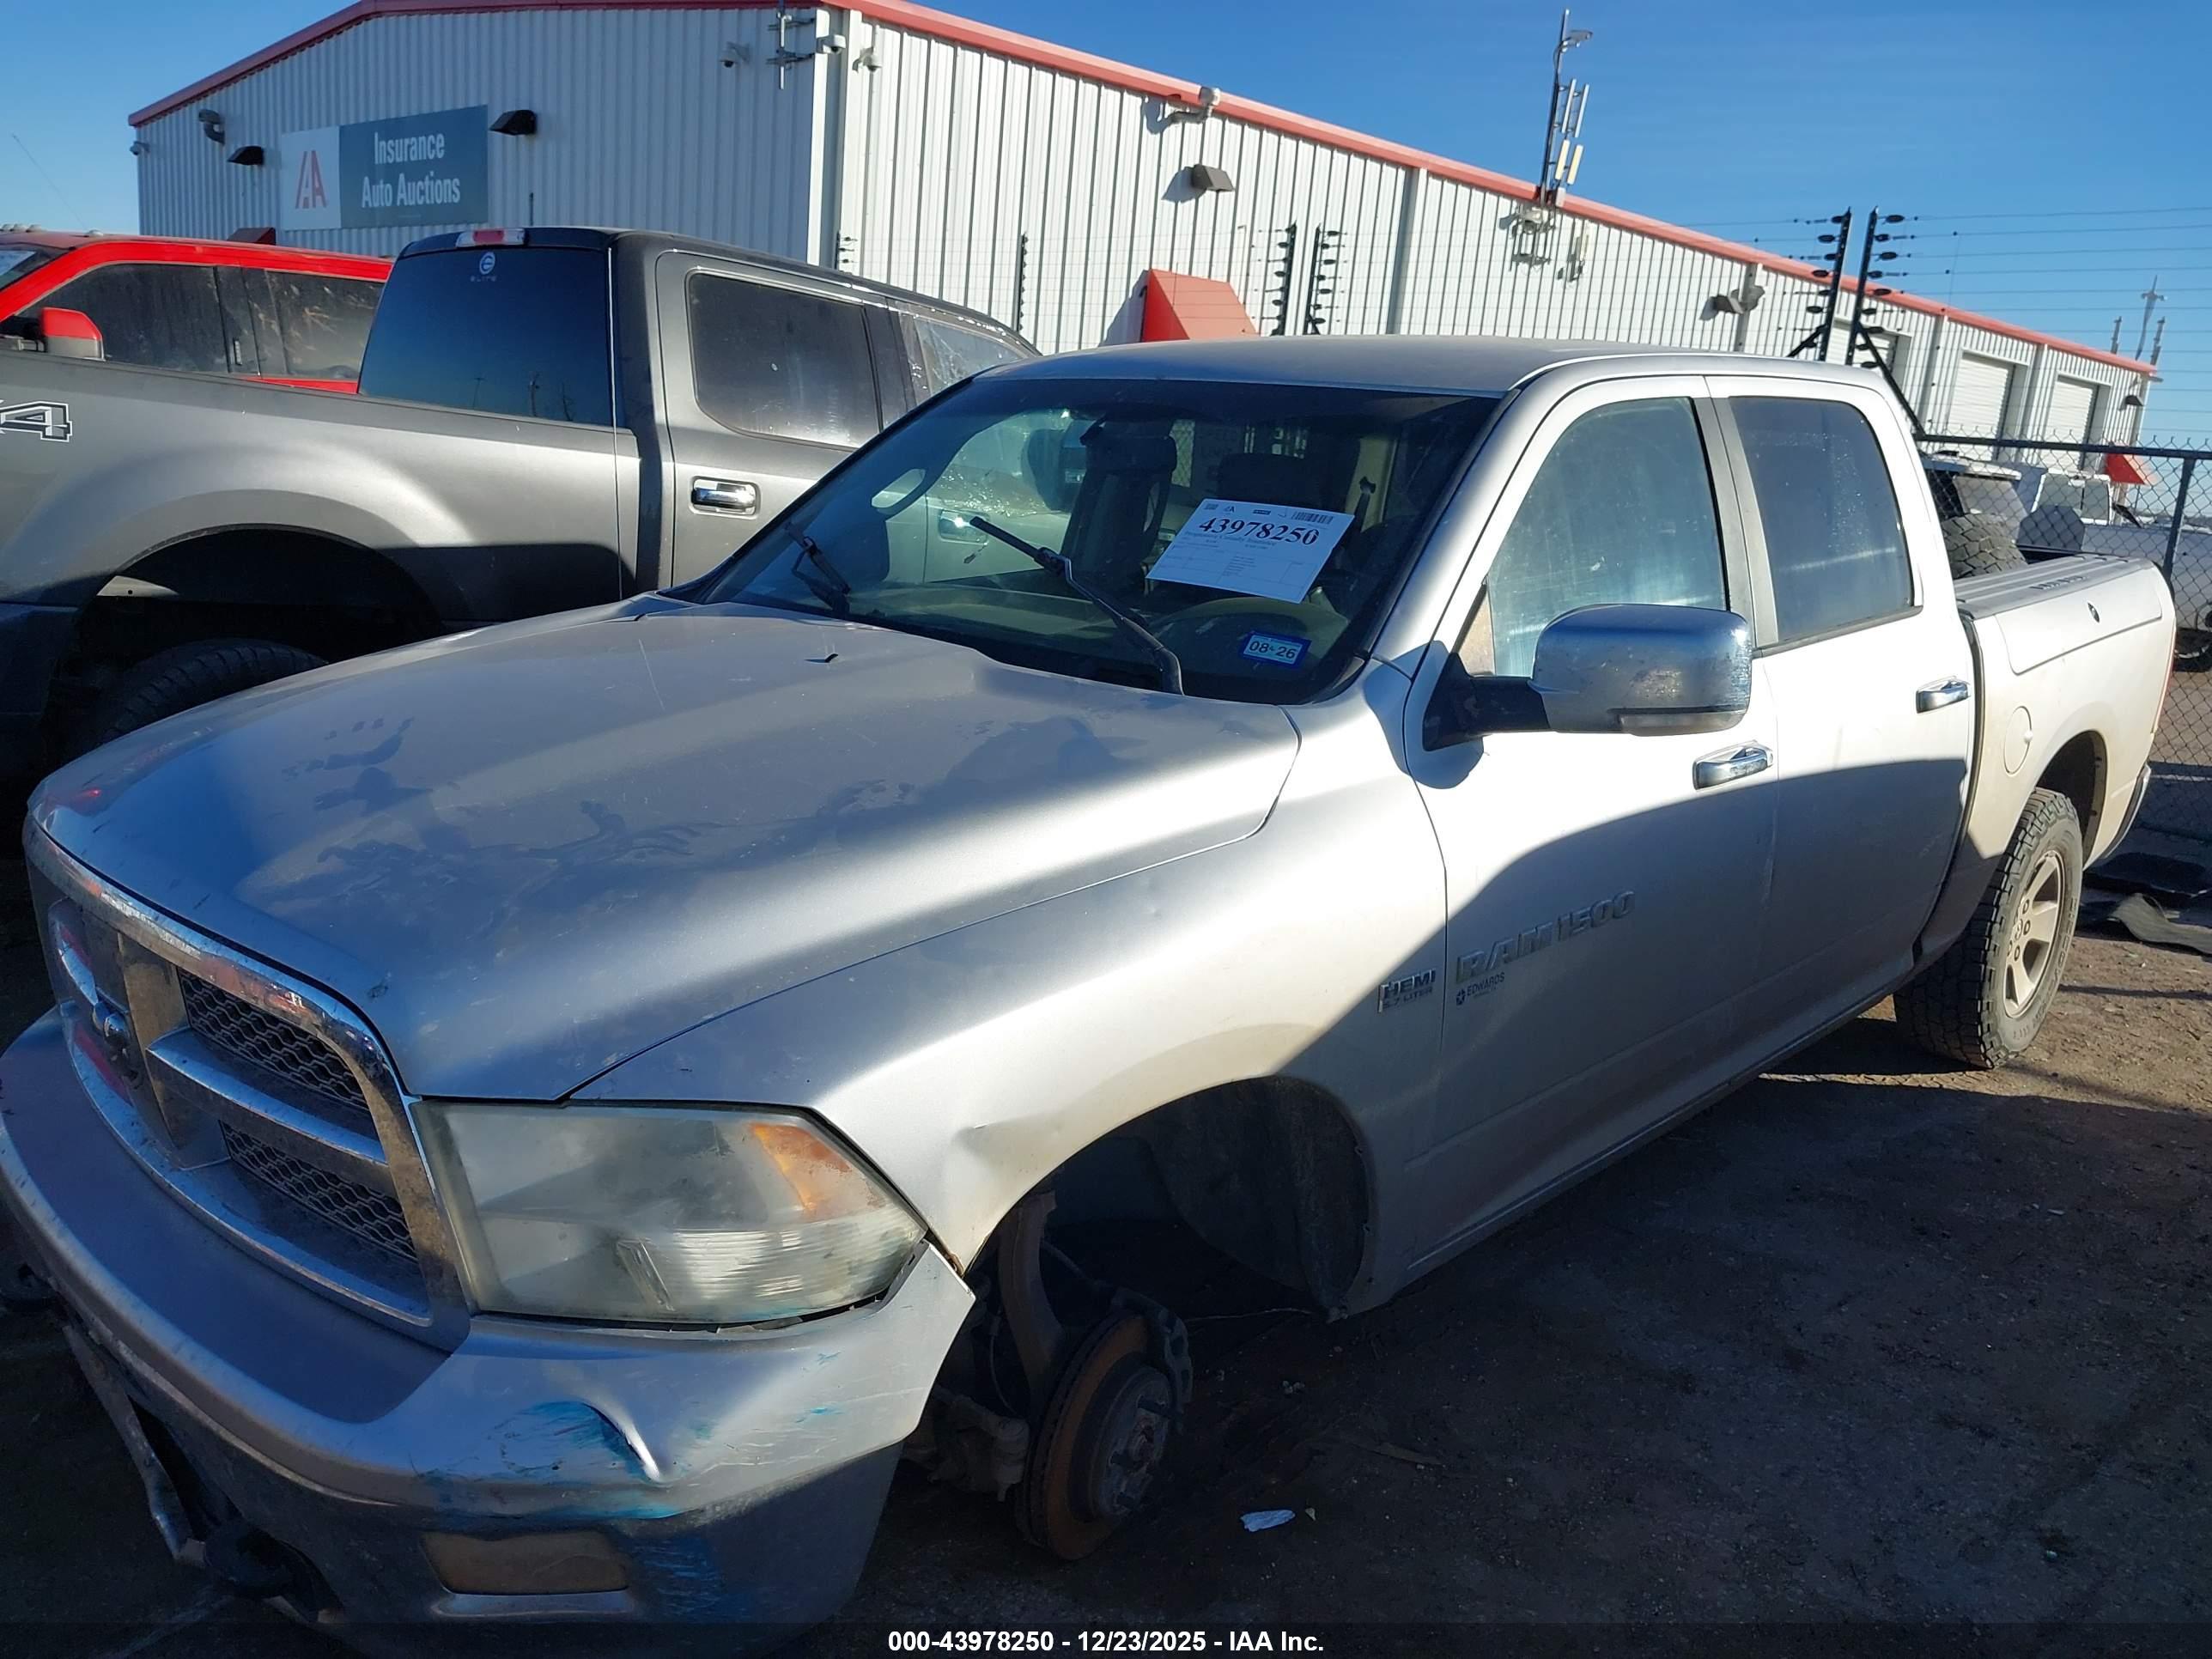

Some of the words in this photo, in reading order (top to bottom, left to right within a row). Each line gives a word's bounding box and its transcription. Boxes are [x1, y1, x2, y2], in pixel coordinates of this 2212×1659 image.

[374, 131, 445, 165] Insurance
[361, 176, 392, 208] Auto
[396, 170, 461, 207] Auctions
[1199, 517, 1320, 546] 43978250
[1455, 921, 1553, 983] RAM
[1558, 890, 1636, 942] 1500
[1379, 968, 1436, 1000] HEMI
[1467, 972, 1505, 997] EDWARDS
